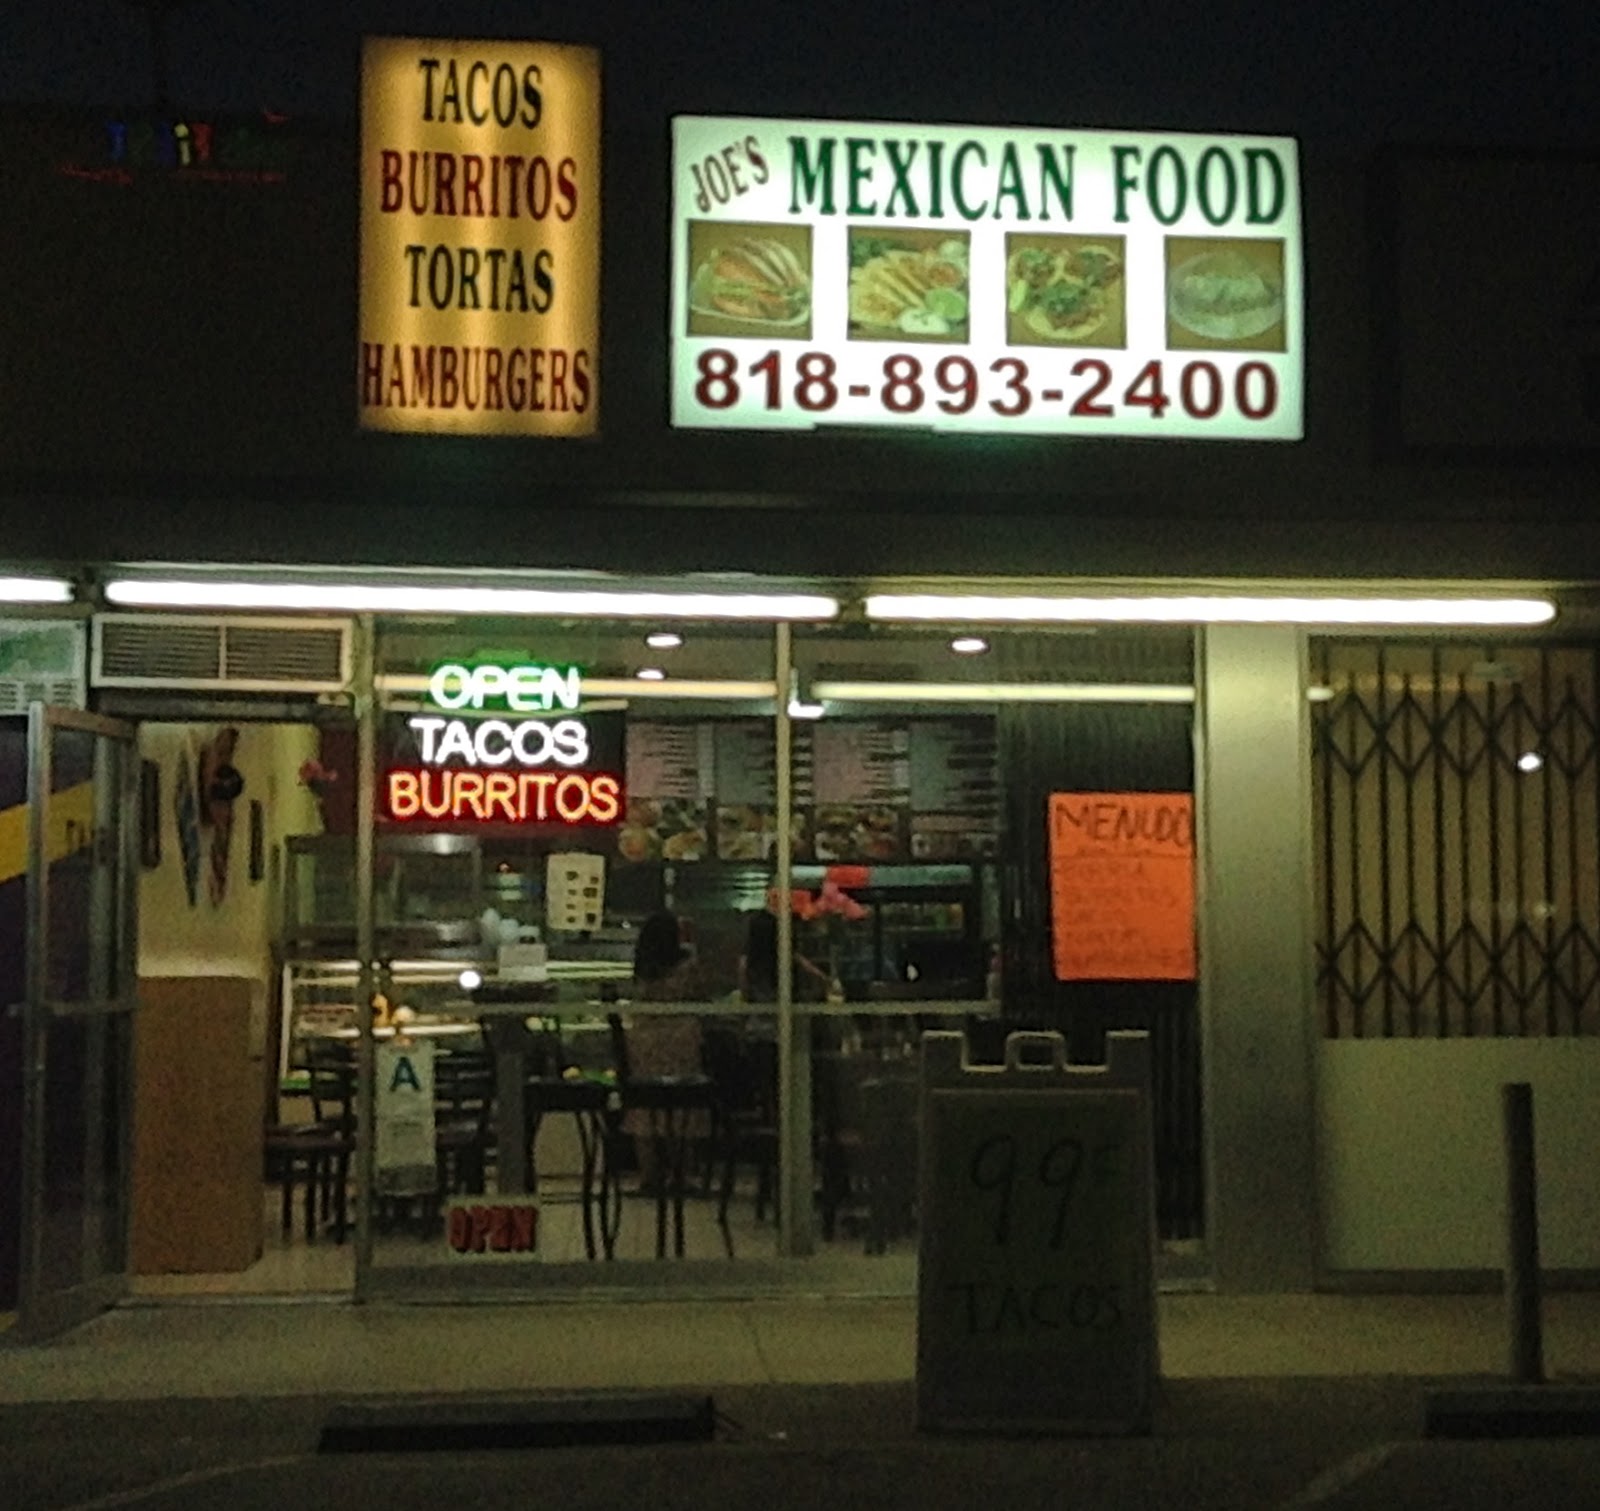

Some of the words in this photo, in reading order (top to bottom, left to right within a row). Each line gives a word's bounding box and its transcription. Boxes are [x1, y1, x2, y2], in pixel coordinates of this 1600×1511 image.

[418, 58, 544, 130] TACOS
[380, 148, 578, 222] BURRITOS
[690, 134, 770, 213] JOE'S
[787, 136, 1077, 221] MEXICAN
[1112, 144, 1286, 226] FOOD
[404, 243, 555, 315] TORTAS
[361, 342, 591, 415] HAMBURGERS
[694, 347, 1280, 420] 818-893-2400
[429, 664, 581, 711] OPEN
[409, 717, 590, 767] TACOS
[388, 769, 620, 822] BURRITOS
[1055, 803, 1191, 848] MENUDO
[389, 1056, 421, 1092] A
[449, 1205, 540, 1253] OPEN
[946, 1282, 1124, 1335] TACOS
